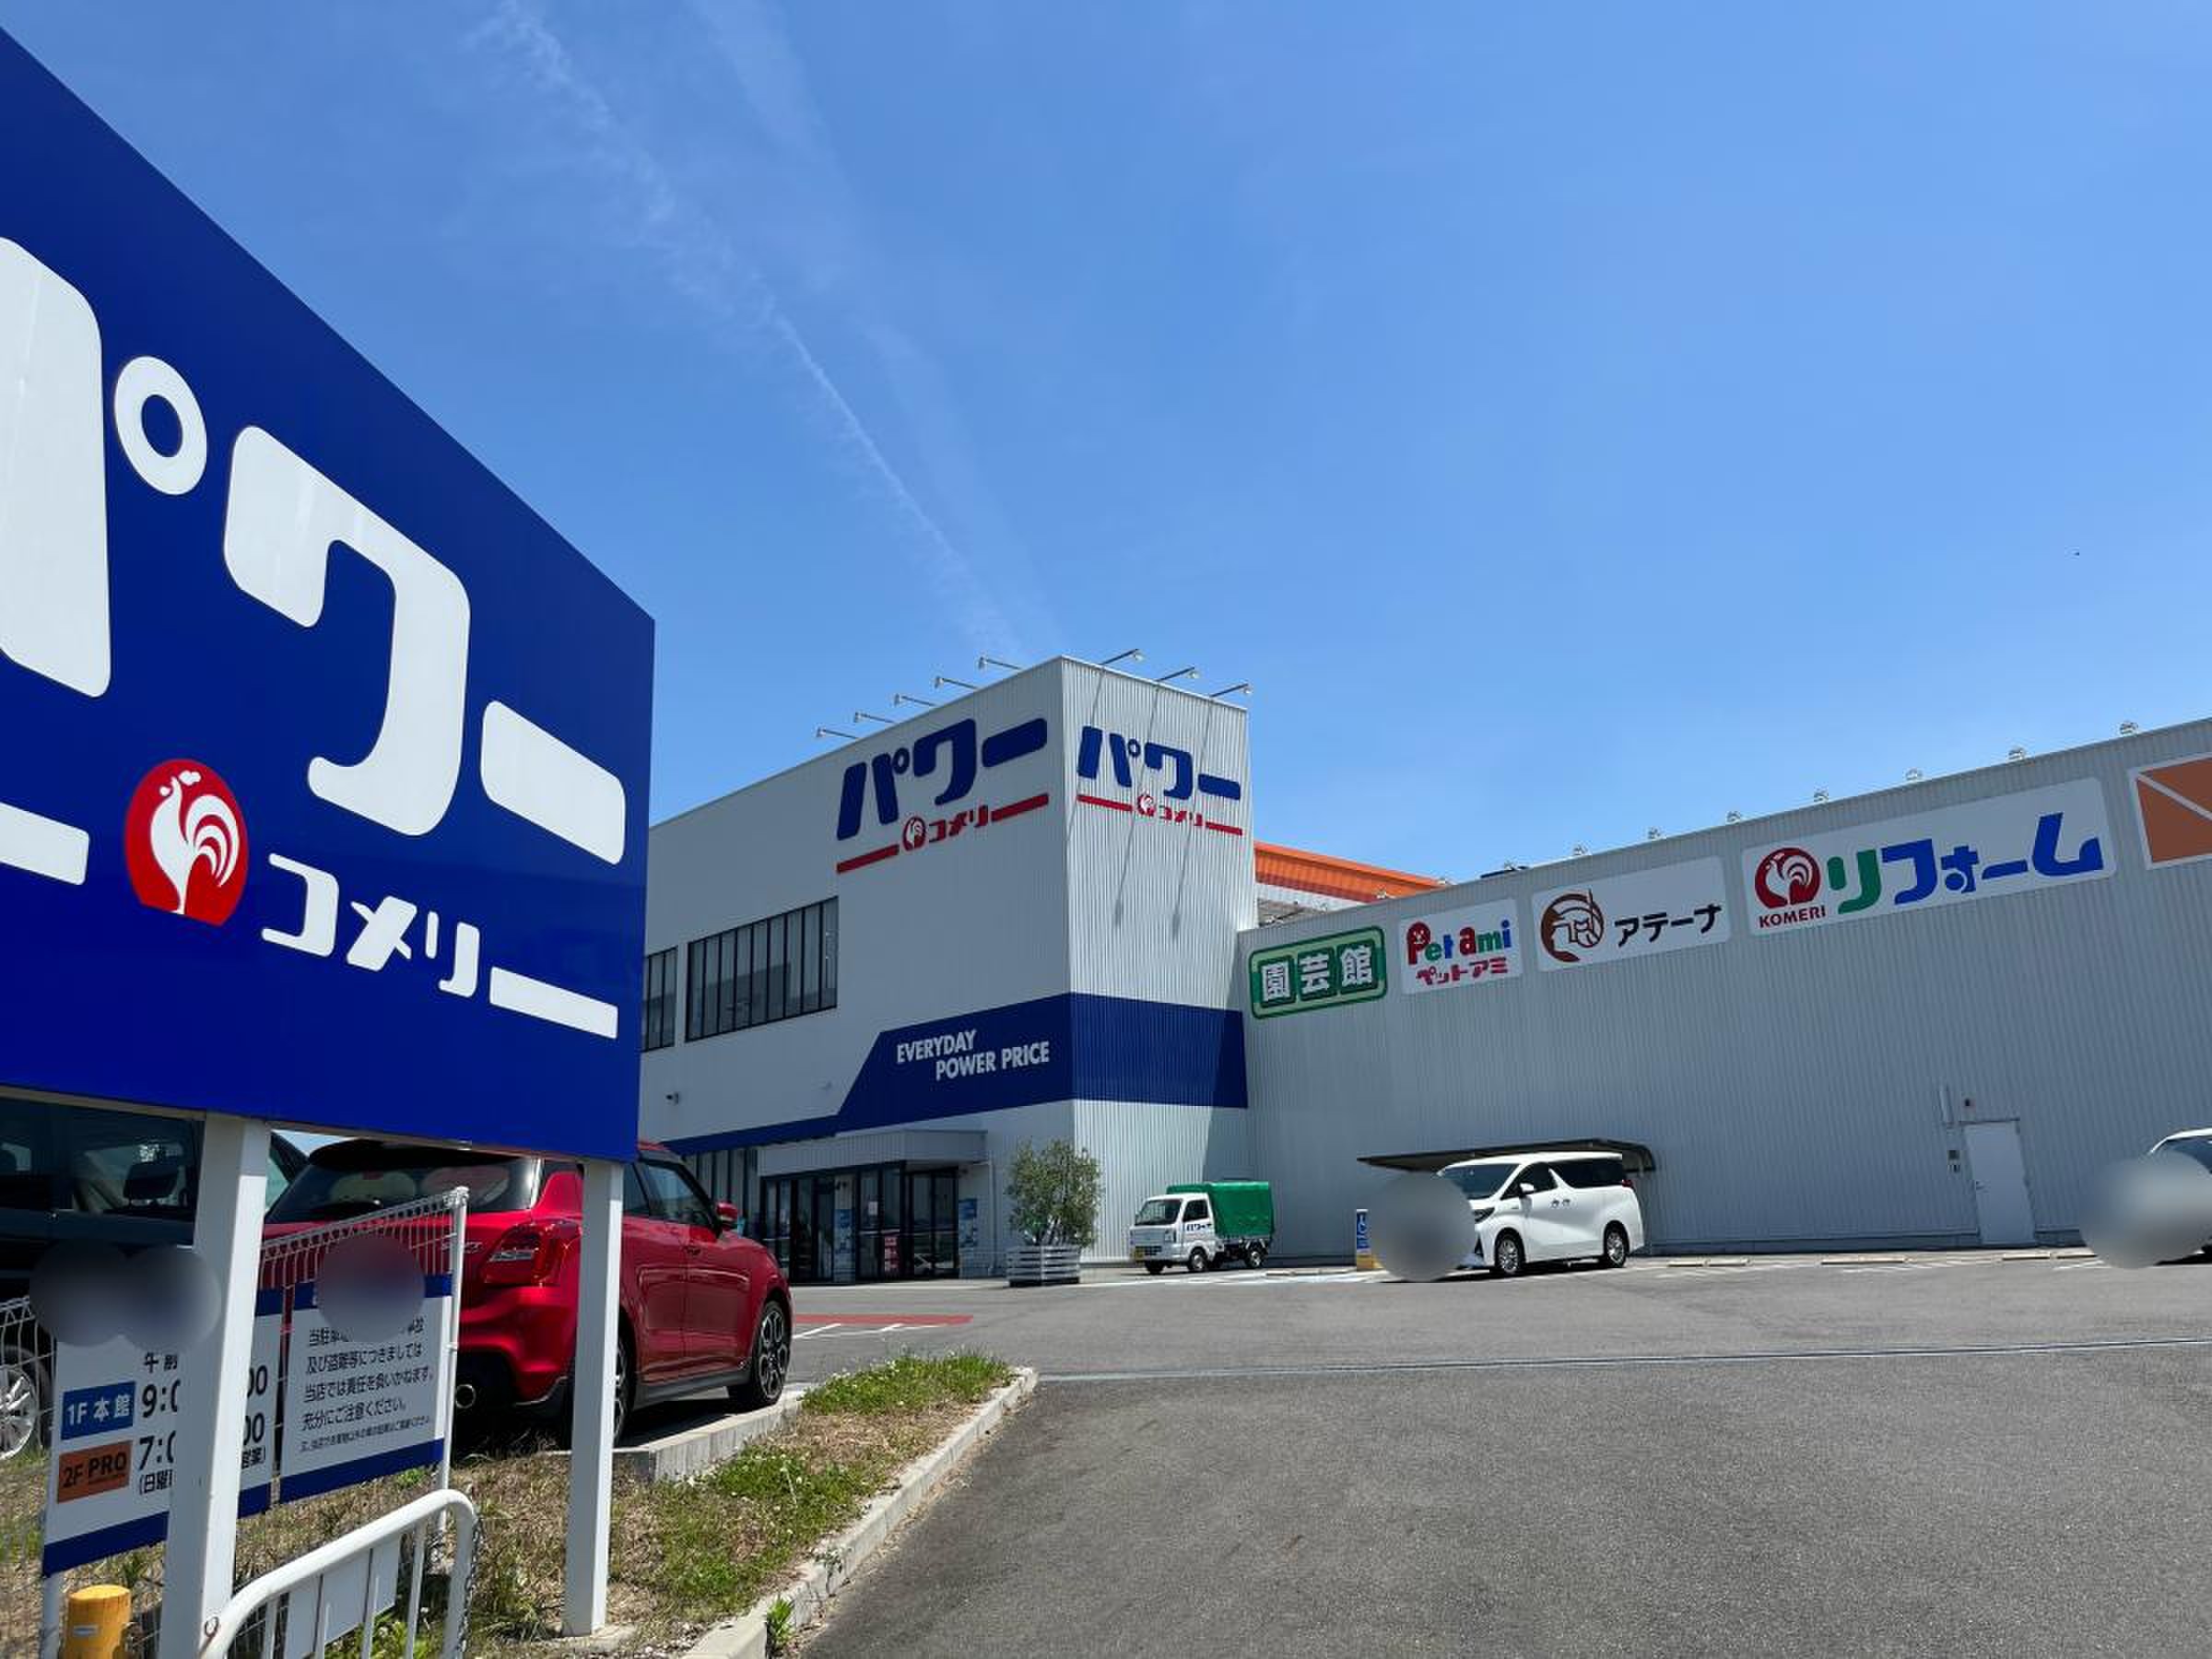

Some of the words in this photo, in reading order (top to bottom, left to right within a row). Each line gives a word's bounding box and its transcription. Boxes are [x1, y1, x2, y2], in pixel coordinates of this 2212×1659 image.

[837, 718, 1048, 841] パワー
[1077, 725, 1241, 800] パワー
[928, 805, 989, 843] コメリ
[1159, 805, 1203, 827] コメリ
[1827, 812, 2104, 915] リフォーム
[261, 853, 480, 998] コメリ
[1614, 903, 1723, 948] アテーナ
[1759, 905, 1826, 928] KOMERI
[1406, 922, 1453, 965] Pet
[1261, 944, 1374, 1002] 園芸館
[1414, 957, 1509, 986] ペットアミ
[896, 1029, 977, 1065] EVERYDAY
[935, 1051, 996, 1082] POWER
[1001, 1041, 1050, 1070] PRICE
[67, 1401, 88, 1426] 1F
[93, 1394, 131, 1421] 本館
[63, 1465, 83, 1488] 2F
[88, 1452, 127, 1477] PRO
